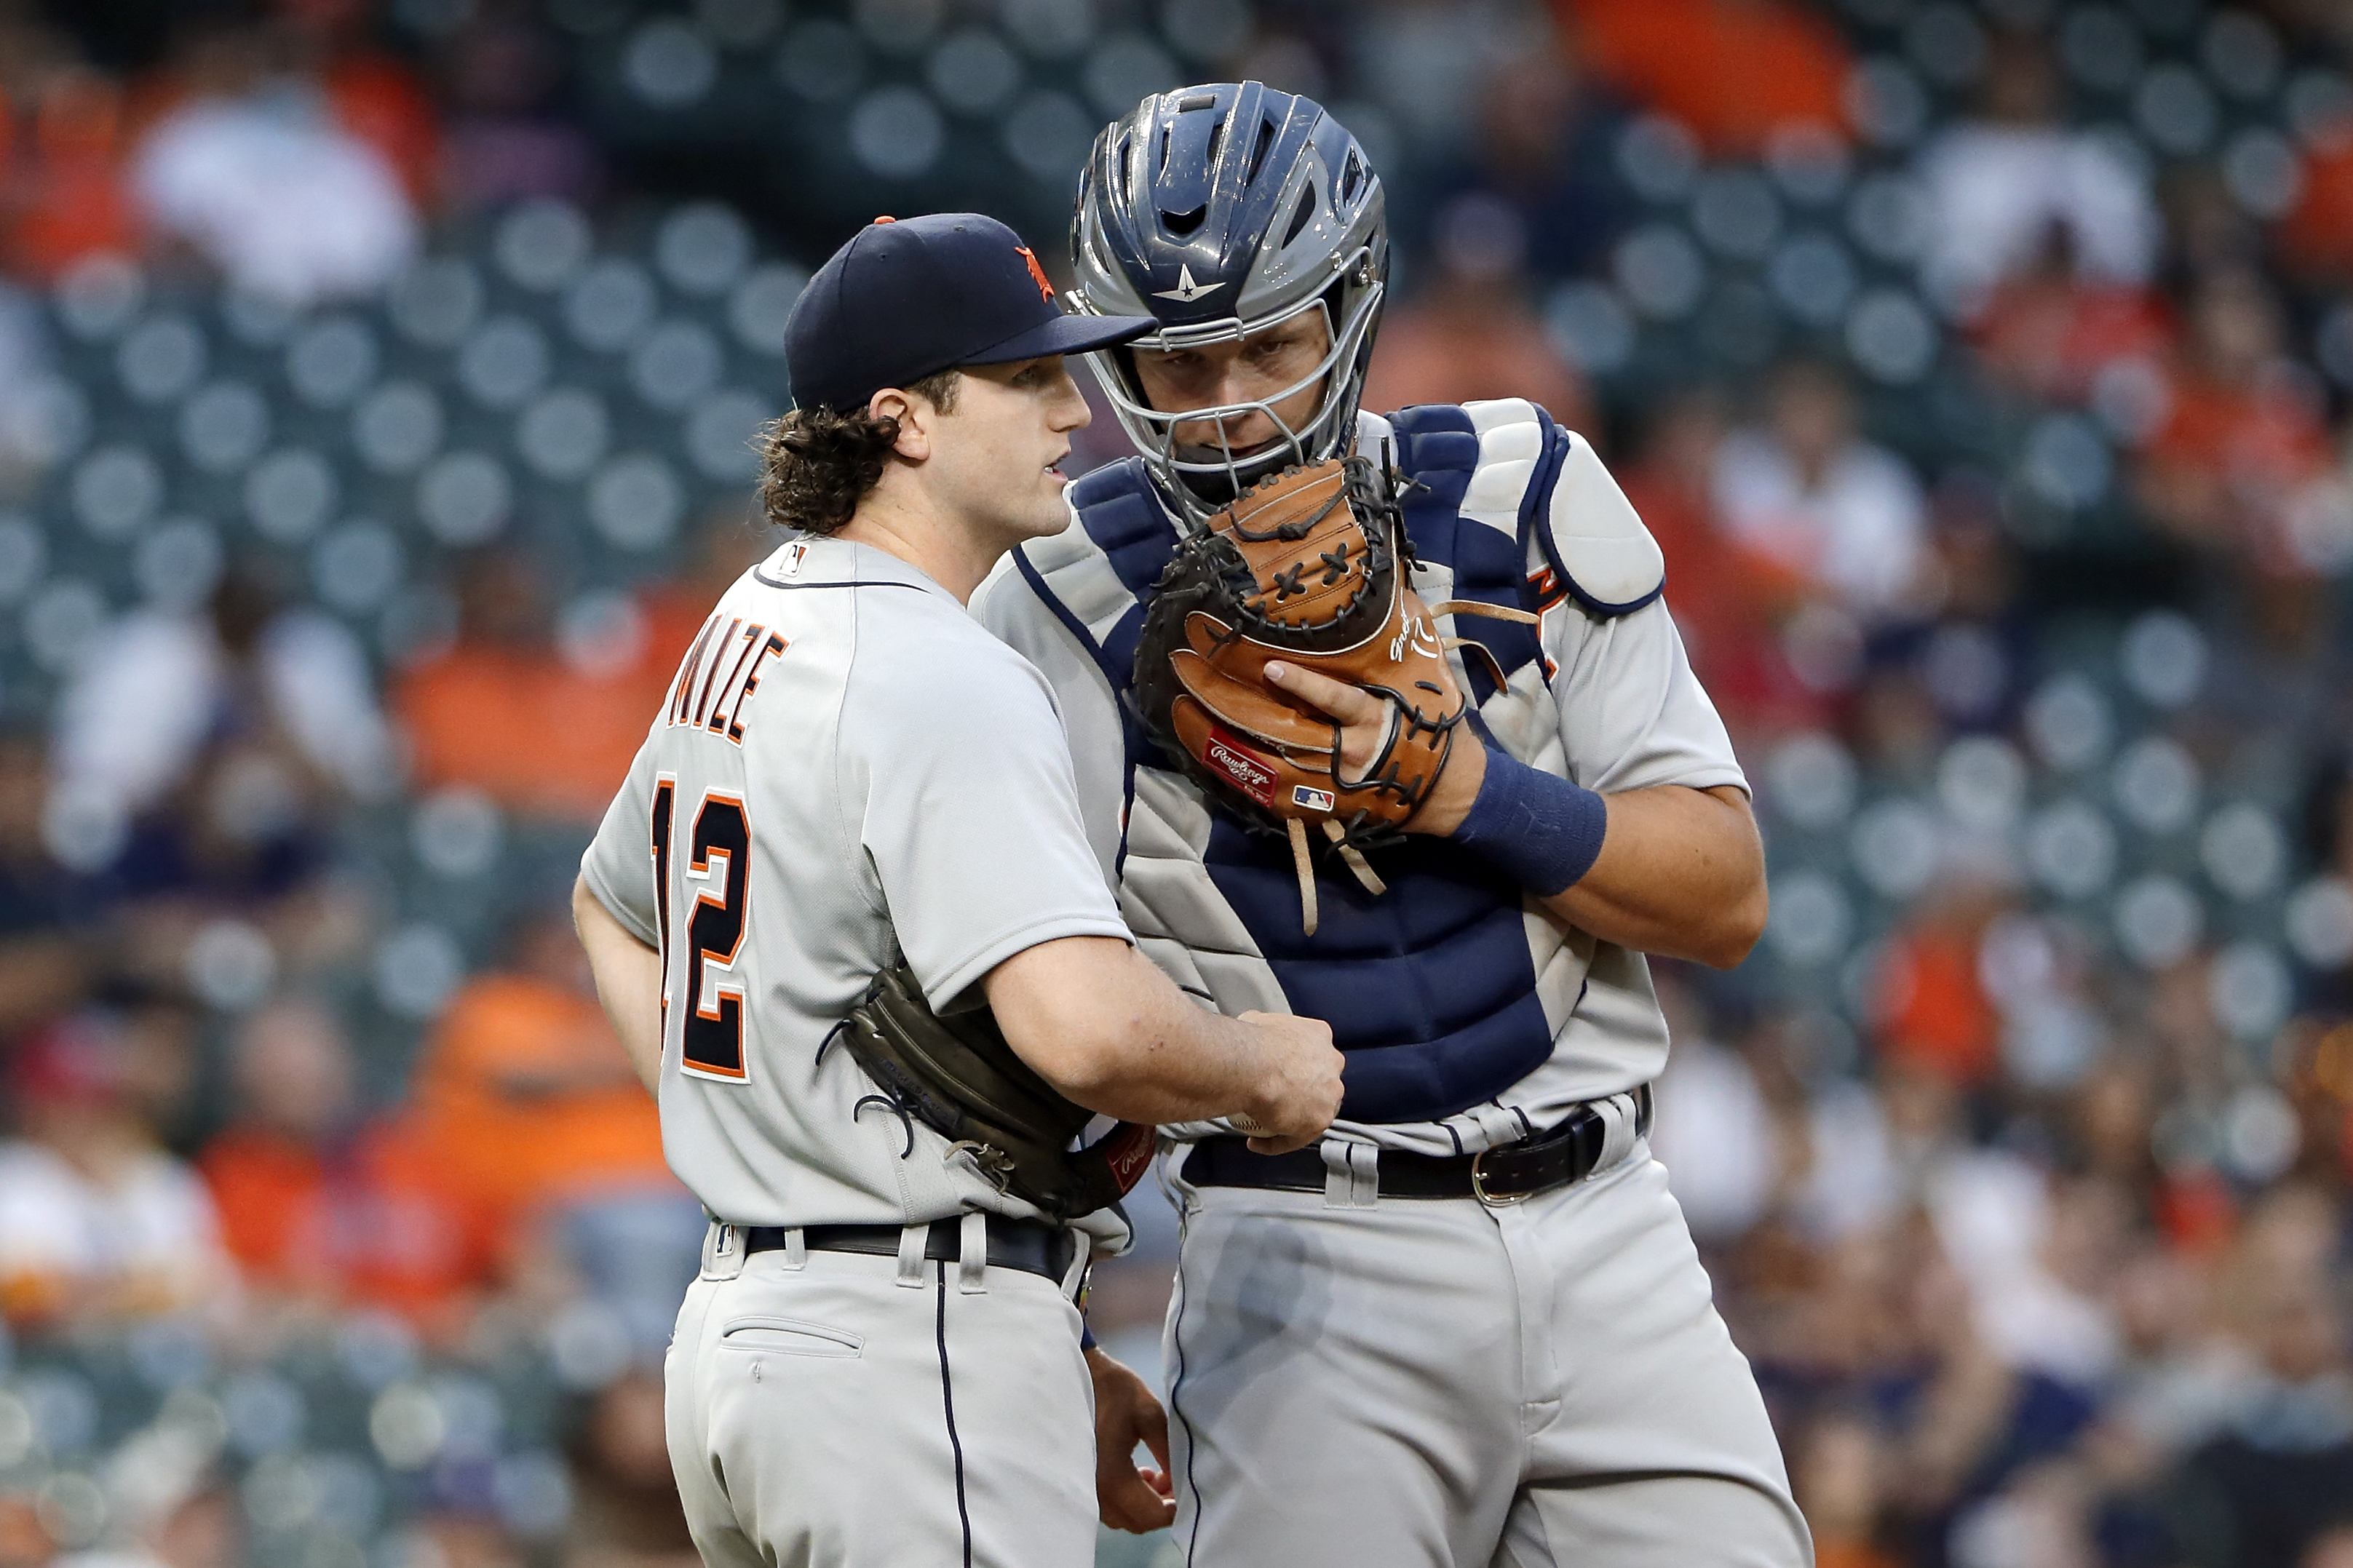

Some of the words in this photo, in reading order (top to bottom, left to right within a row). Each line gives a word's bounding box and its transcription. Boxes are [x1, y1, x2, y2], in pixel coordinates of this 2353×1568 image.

[1410, 616, 1438, 659] 17
[666, 613, 790, 746] MIZE
[1210, 746, 1270, 784] Rawlings
